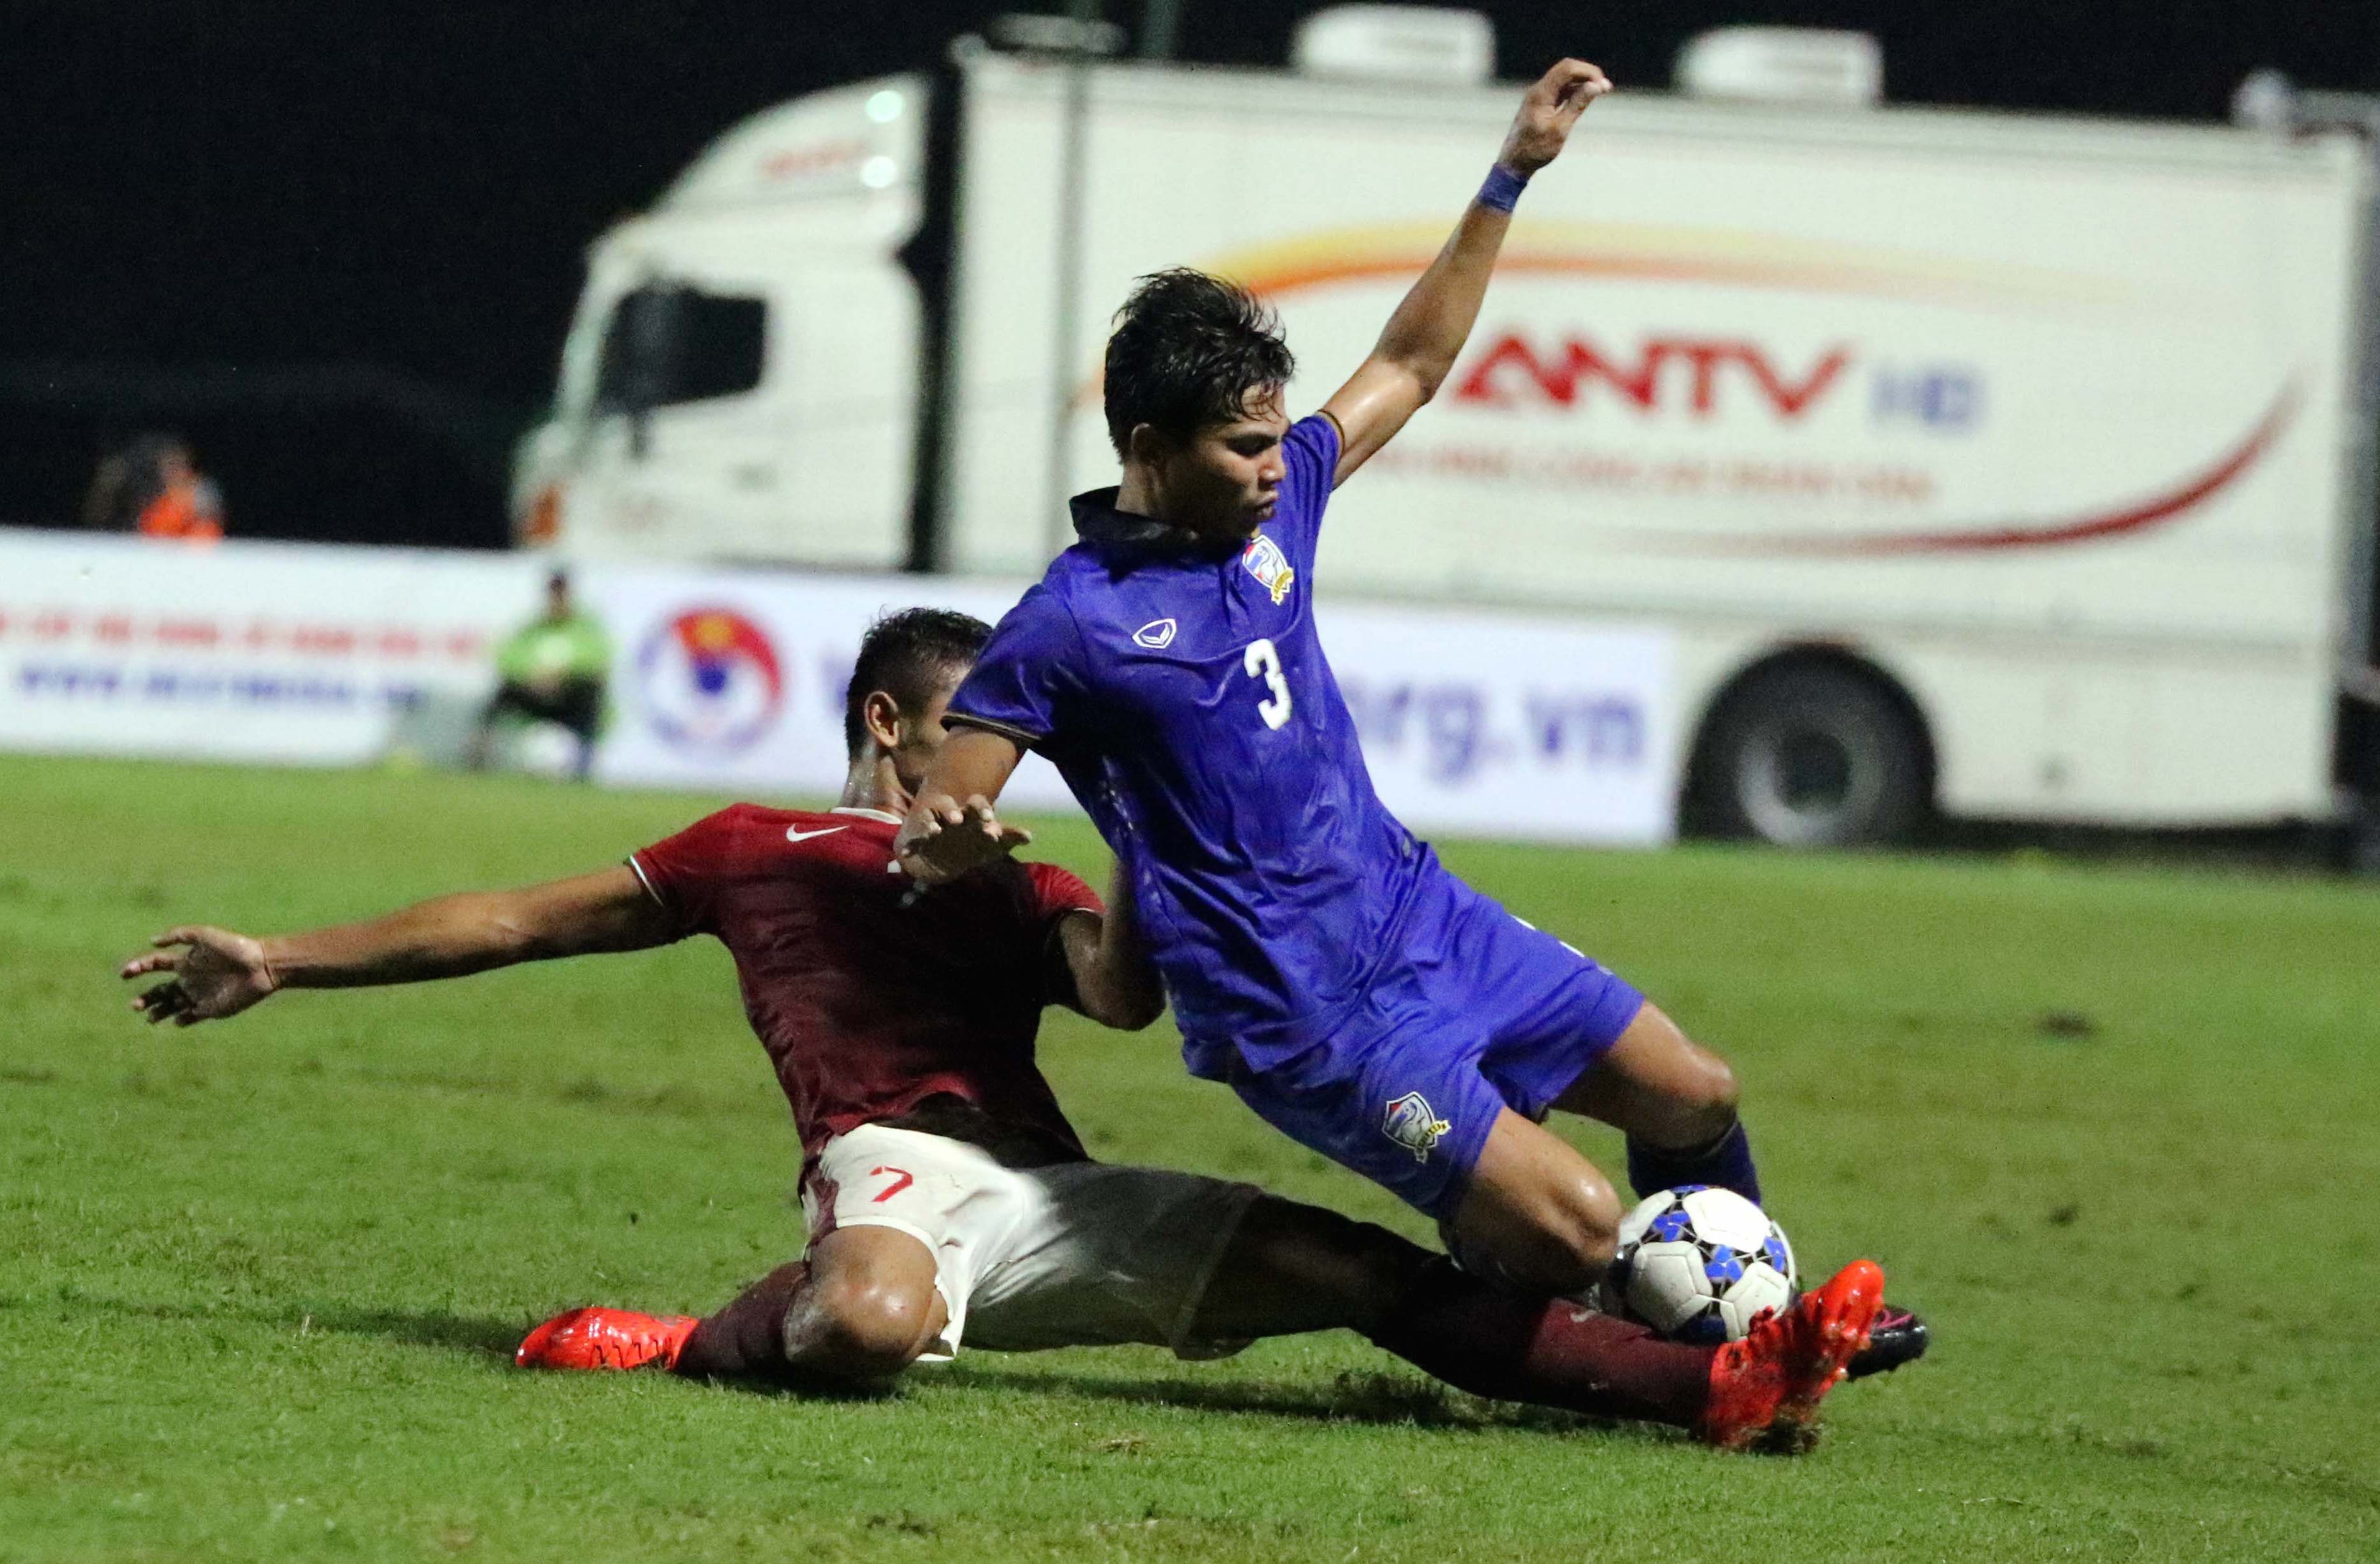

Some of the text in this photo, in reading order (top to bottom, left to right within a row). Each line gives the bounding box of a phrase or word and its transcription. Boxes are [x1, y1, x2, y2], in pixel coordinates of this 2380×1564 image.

[1449, 332, 1854, 423] ANTV
[1243, 638, 1292, 731] 3
[869, 1166, 914, 1202] 7
